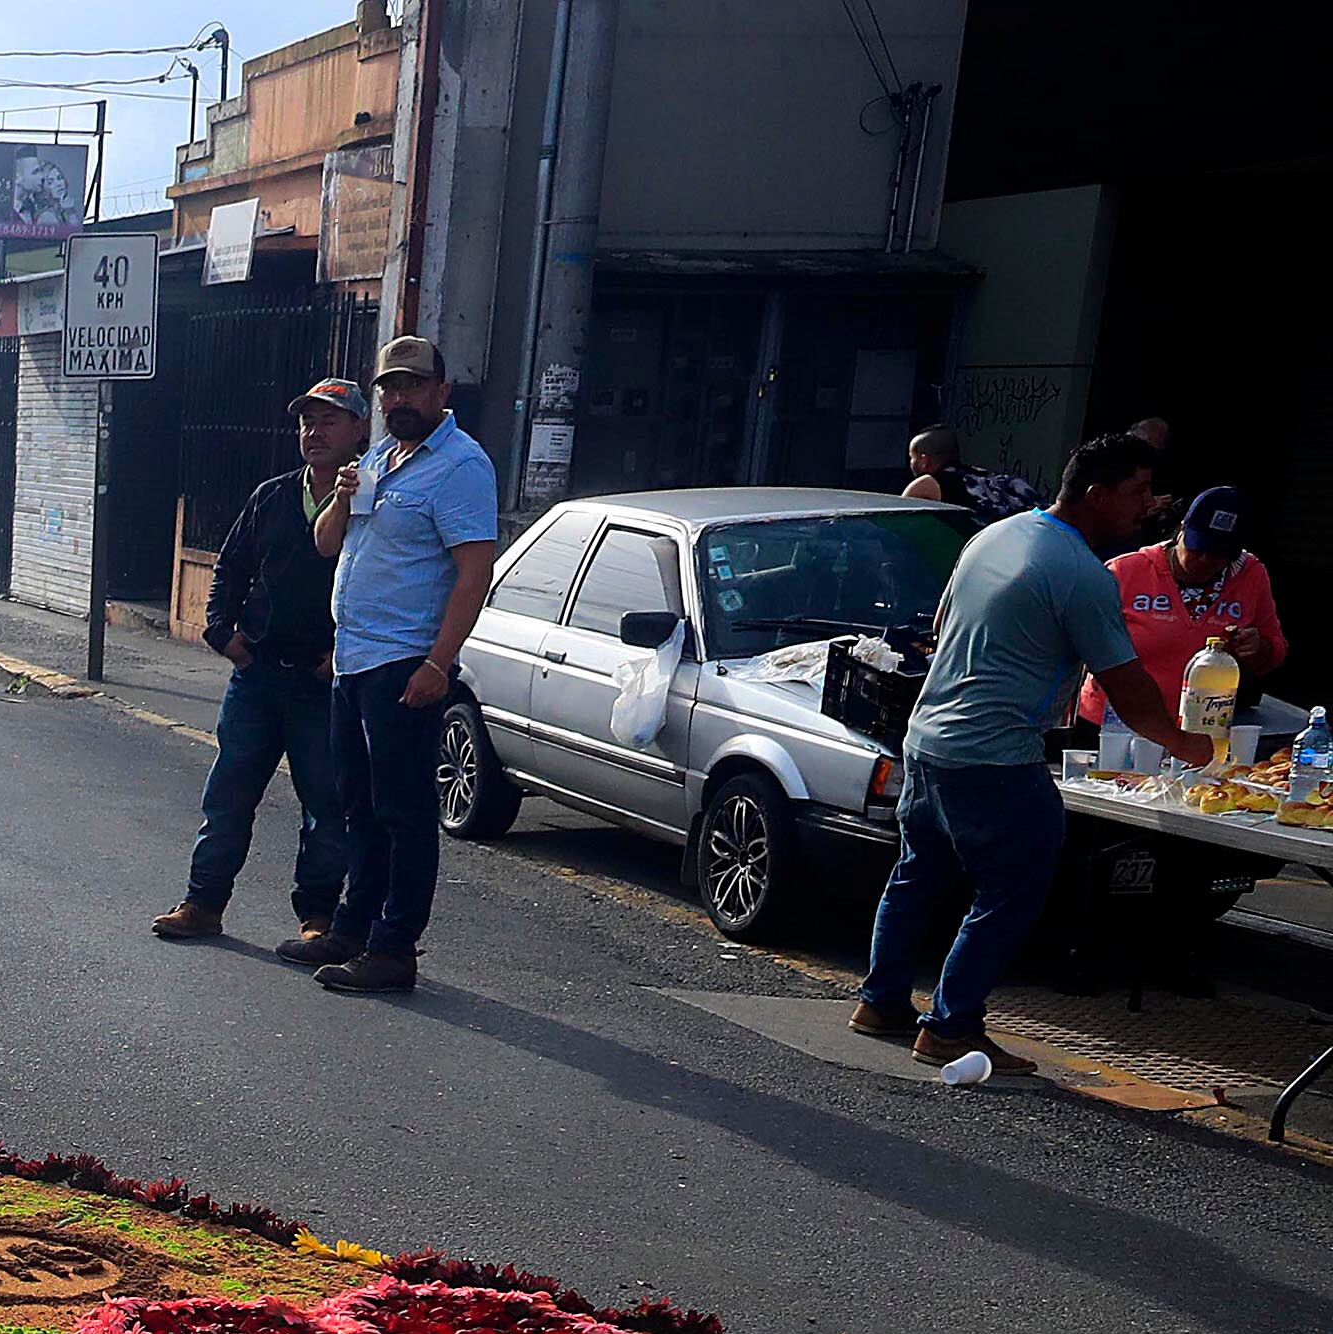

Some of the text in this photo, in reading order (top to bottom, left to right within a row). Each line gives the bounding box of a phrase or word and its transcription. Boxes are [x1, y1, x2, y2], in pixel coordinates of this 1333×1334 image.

[93, 254, 129, 288] 40
[97, 292, 123, 309] KPH
[68, 326, 150, 348] VELOCIDAD
[69, 350, 148, 373] MAXIMA
